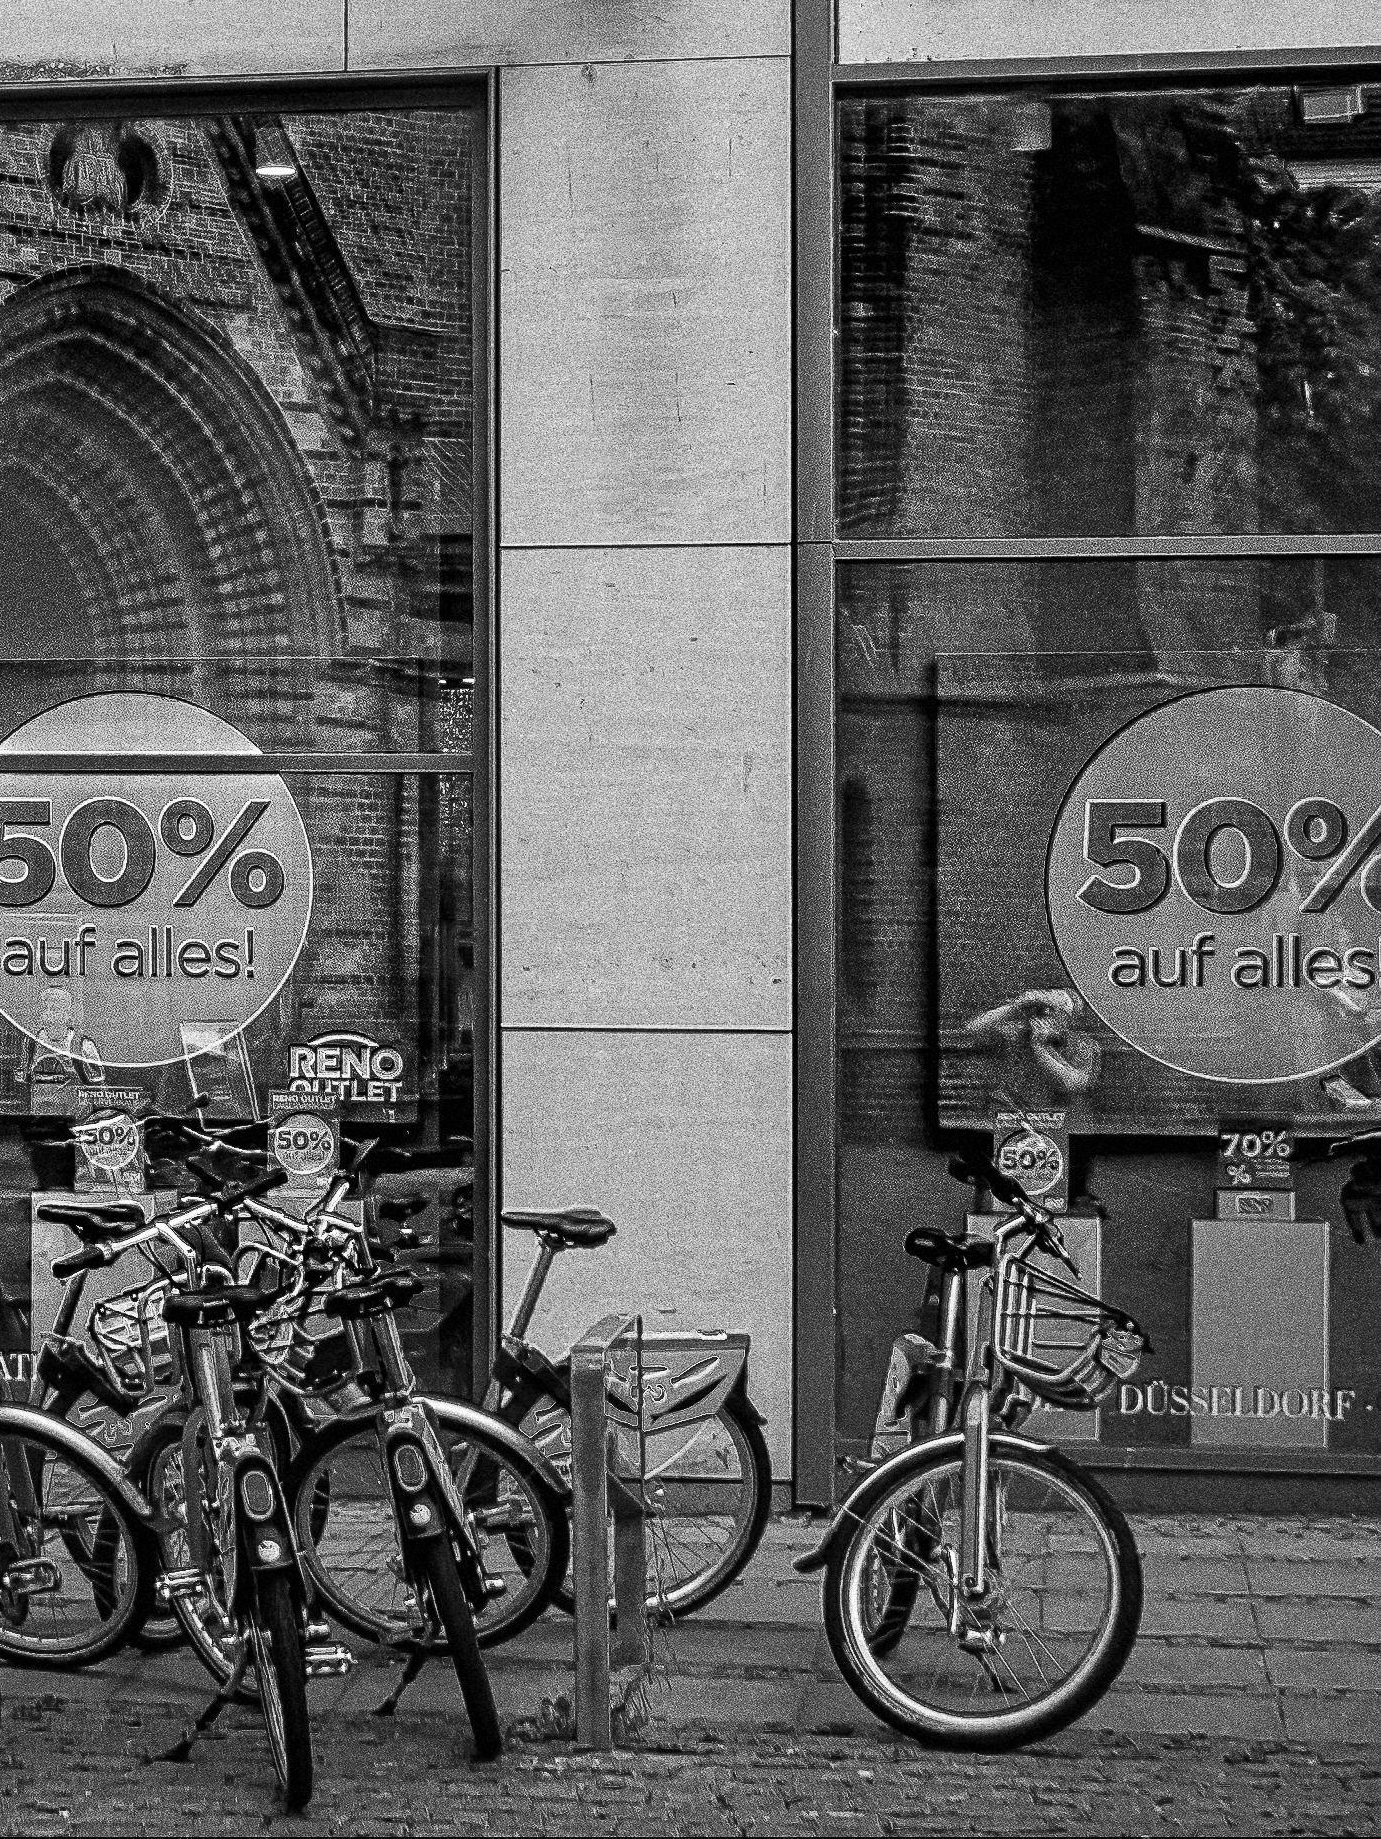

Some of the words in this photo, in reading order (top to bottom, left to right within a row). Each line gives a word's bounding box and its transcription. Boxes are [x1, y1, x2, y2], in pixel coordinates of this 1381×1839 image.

[1076, 797, 1381, 916] 50%
[3, 925, 96, 979] auf
[113, 926, 256, 980] alles!
[1110, 932, 1215, 989] auf
[289, 1045, 403, 1079] RENO
[289, 1078, 403, 1102] OUTLET
[300, 1095, 337, 1103] OUTLET
[80, 1126, 136, 1146] 50%
[277, 1130, 331, 1151] 50%
[1220, 1130, 1291, 1157] 70%
[1002, 1149, 1060, 1170] 50%
[1119, 1380, 1356, 1420] DÜSSELDORF
